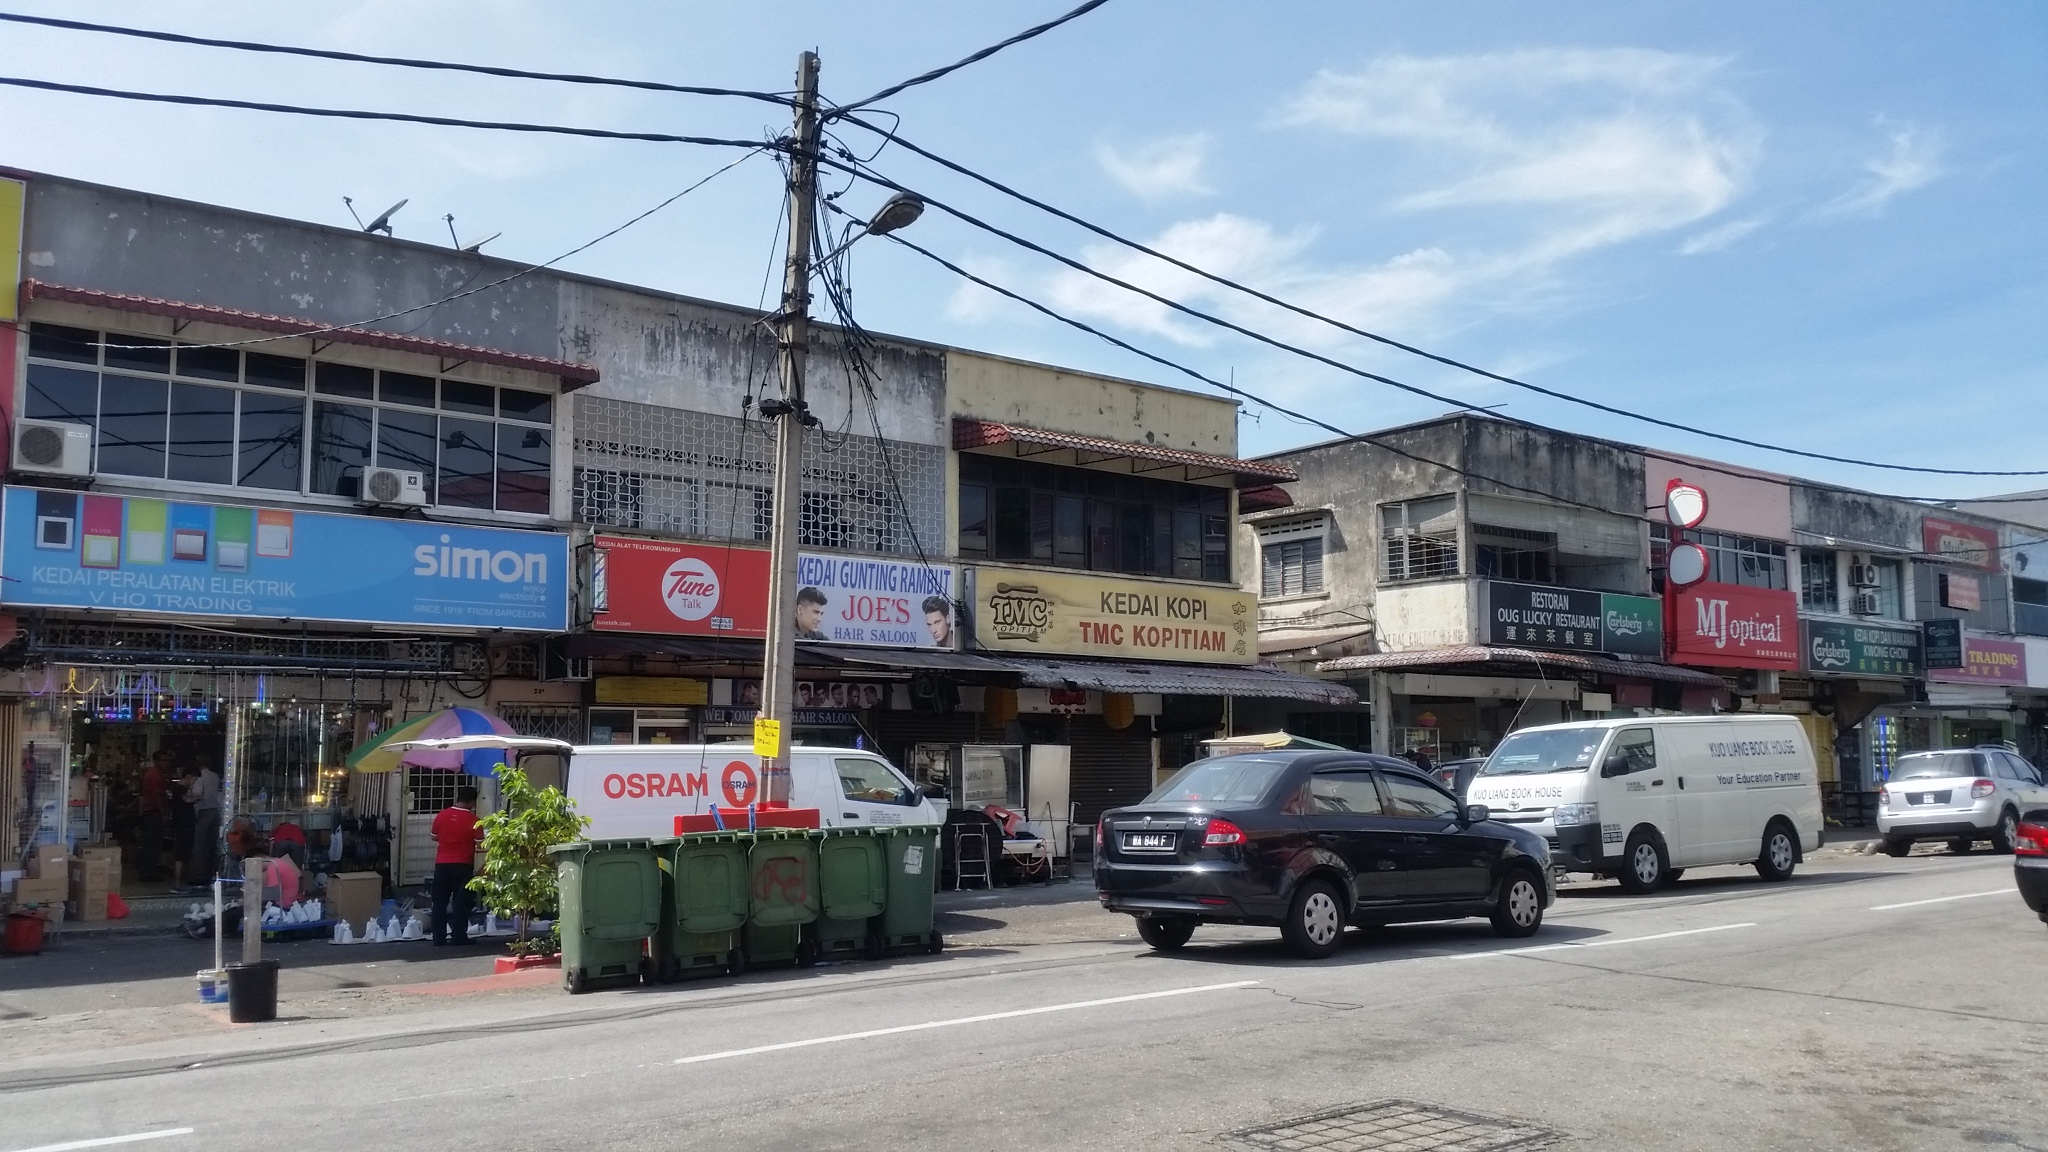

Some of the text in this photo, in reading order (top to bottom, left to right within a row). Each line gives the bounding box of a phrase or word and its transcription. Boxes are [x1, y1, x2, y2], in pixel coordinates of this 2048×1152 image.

[632, 544, 680, 552] TELEKOMUNIKASI
[414, 534, 547, 584] simon
[32, 566, 296, 598] KEDAI PERALATAN ELEKTRIK
[667, 570, 714, 598] Tune
[798, 557, 951, 596] KEDAI GUNTING RAMBUT
[500, 592, 539, 602] electricity
[523, 585, 546, 594] enjoy
[89, 590, 104, 604] V
[113, 592, 146, 606] HO
[152, 594, 252, 612] TRADING
[682, 598, 702, 609] Talk
[842, 595, 910, 624] JOE'S
[1100, 591, 1207, 620] KEDAI KOPI
[1532, 592, 1568, 610] RESTORAN
[414, 604, 546, 618] SINCE 1916 FROM BARCELONA
[990, 595, 1047, 628] TMC
[1498, 608, 1600, 630] OUG LUCKY RESTAURANT
[992, 625, 1046, 634] KOPITIAM
[1606, 610, 1642, 634] Carlsberg
[1696, 597, 1782, 648] MJ optical
[834, 626, 917, 644] HAIR SALOON
[1080, 622, 1226, 652] TMC KOPITIAM
[1813, 637, 1850, 663] Carlsberg
[1864, 645, 1908, 660] KWONG CHOW
[1968, 650, 2018, 666] TRADING
[793, 711, 816, 723] HAIR
[1709, 740, 1796, 757] KUO LIANG BOOK HOUSE
[604, 772, 708, 800] OSRAM
[722, 780, 756, 790] OSRAM
[1717, 771, 1802, 785] Your Education Partner
[1474, 786, 1562, 800] KUO LIANG BOOK HOUSE
[1161, 835, 1167, 846] F
